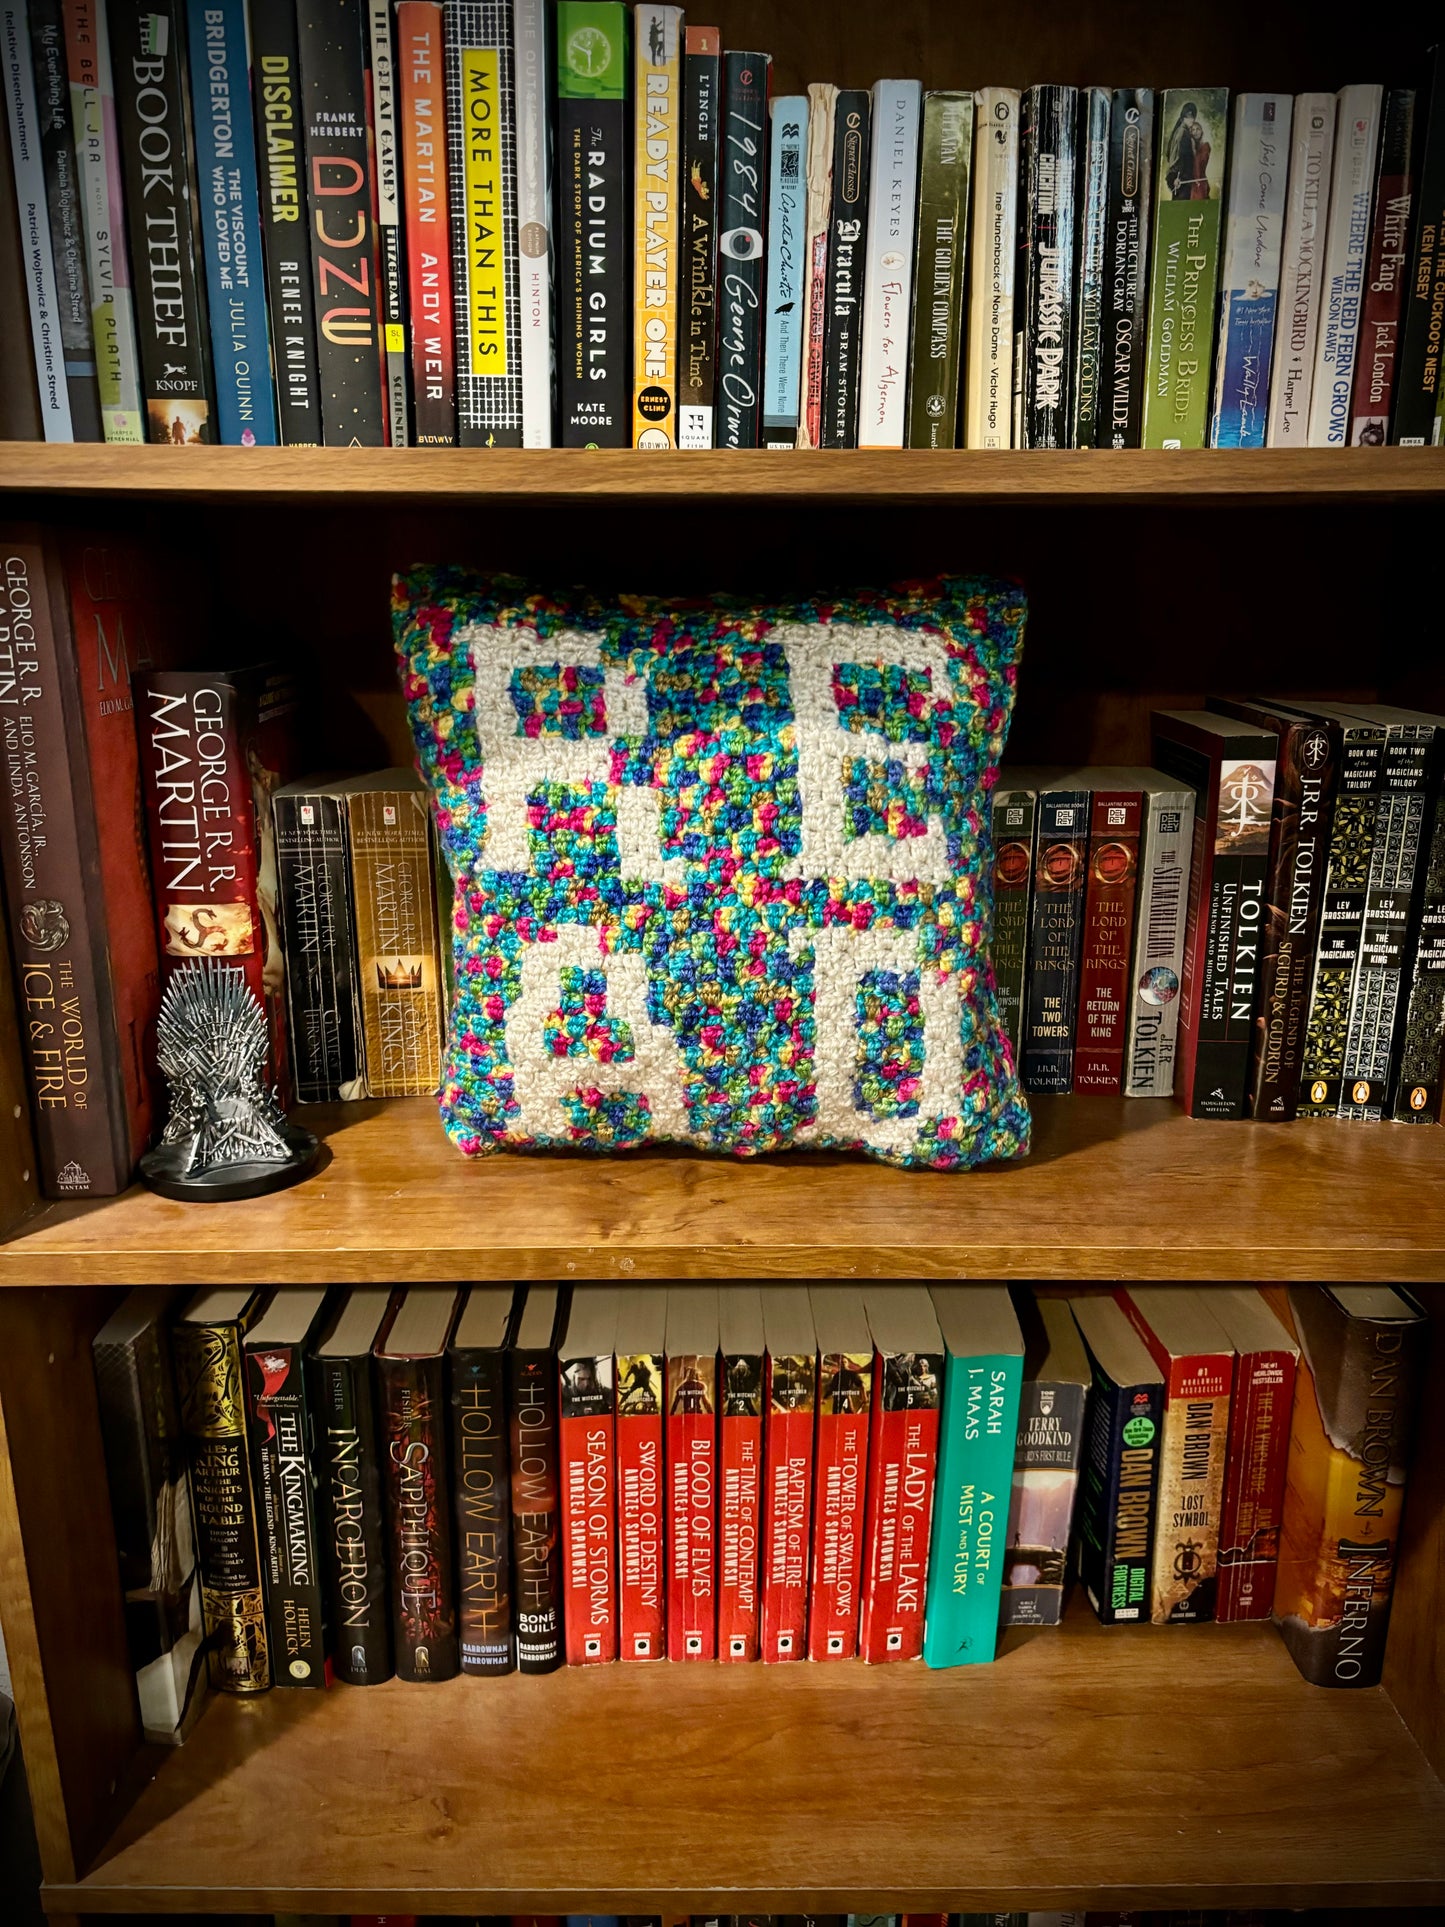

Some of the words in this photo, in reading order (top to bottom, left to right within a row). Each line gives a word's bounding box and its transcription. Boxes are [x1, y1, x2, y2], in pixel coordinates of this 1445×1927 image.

[75, 4, 91, 43] THE
[412, 32, 432, 84] THE
[79, 59, 96, 109] BELL
[204, 9, 235, 159] BRIDGERTON
[698, 75, 710, 142] L'ENGLE
[133, 56, 175, 200] BOOK
[261, 56, 300, 222] DISCLAIMER
[310, 126, 364, 138] HERBERT
[315, 112, 356, 123] FRANK
[469, 69, 492, 162] MORE
[646, 74, 670, 183] READY
[893, 100, 906, 169] DANIEL
[86, 124, 102, 163] JAR
[414, 99, 438, 223] MARTIAN
[727, 110, 763, 217] 1984
[889, 180, 902, 237] KEYES
[1038, 153, 1056, 215] CRICHTON
[28, 203, 40, 246] Patricia
[473, 180, 496, 268] THAN
[588, 151, 606, 274] RADIUM
[692, 213, 709, 233] A
[935, 216, 955, 244] THE
[1128, 218, 1138, 241] THE
[644, 191, 669, 309] PLAYER
[1115, 221, 1127, 276] DORIAN
[1420, 224, 1437, 254] KEN
[32, 249, 46, 308] Wojtowicz
[96, 231, 114, 304] SYLVIA
[146, 206, 188, 348] THIEF
[420, 252, 441, 325] ANDY
[691, 234, 713, 316] Wrinkle
[933, 247, 953, 296] GOLDEN
[1127, 241, 1140, 300] PICTURE
[1164, 241, 1181, 312] WILLIAM
[1415, 256, 1433, 301] KESEY
[39, 311, 49, 319] &
[531, 272, 541, 328] HINTON
[881, 282, 902, 330] Flowers
[1037, 241, 1066, 345] JURASSIC
[1112, 278, 1125, 312] GRAY
[1126, 301, 1135, 316] OF
[229, 298, 247, 352] JULIA
[476, 286, 498, 356] THIS
[589, 292, 607, 381] GIRLS
[690, 320, 707, 336] in
[779, 337, 790, 351] Then
[780, 320, 790, 334] And
[929, 300, 950, 360] COMPASS
[1370, 319, 1398, 351] Jack
[41, 322, 54, 371] Christine
[104, 318, 122, 382] PLATH
[424, 336, 443, 401] WEIR
[644, 317, 668, 379] ONE
[689, 341, 711, 389] Time
[778, 353, 790, 374] There
[838, 332, 849, 373] BRAM
[882, 338, 894, 354] for
[1113, 319, 1133, 375] OSCAR
[1156, 317, 1175, 398] GOLDMAN
[48, 374, 61, 410] Streed
[155, 379, 198, 391] KNOPF
[234, 360, 254, 422] QUINN
[777, 375, 789, 394] Were
[876, 365, 899, 426] Algernon
[989, 368, 1000, 394] Victor
[1035, 347, 1065, 410] PARK
[1369, 352, 1396, 404] London
[570, 417, 613, 426] MOORE
[576, 402, 606, 412] KATE
[776, 395, 788, 414] None
[835, 377, 848, 438] STOKER
[987, 396, 999, 429] Hugo
[1111, 376, 1130, 431] WILDE
[3, 716, 19, 751] AND
[192, 688, 233, 823] GEORGE
[8, 754, 24, 798] LINDA
[146, 688, 206, 894] MARTIN
[1299, 775, 1322, 833] J.R.R.
[14, 802, 37, 890] ANTONSSON
[204, 830, 233, 859] R.
[357, 838, 398, 846] BESTSELLING
[399, 837, 425, 845] AUTHOR
[208, 864, 237, 894] R.
[1287, 837, 1316, 937] TOLKIEN
[291, 863, 321, 953] MARTIN
[374, 862, 402, 951] MARTIN
[1365, 910, 1406, 920] GROSSMAN
[1034, 959, 1076, 972] RINGS
[1230, 879, 1263, 1022] TOLKIEN
[1294, 957, 1306, 978] THE
[1362, 944, 1399, 954] MAGICIAN
[1032, 1025, 1069, 1037] TOWERS
[1086, 1001, 1120, 1012] RETURN
[1284, 979, 1304, 1049] LEGEND
[303, 1008, 323, 1075] THRONES
[380, 1002, 406, 1073] KINGS
[1131, 1010, 1163, 1090] TOLKIEN
[1284, 1050, 1296, 1071] OF
[1027, 1077, 1068, 1086] TOLKIEN
[1078, 1076, 1119, 1085] TOLKIEN
[906, 1385, 926, 1393] WITCHER
[1197, 1367, 1208, 1378] #1
[1251, 1376, 1284, 1386] BESTSELLER
[1368, 1331, 1404, 1398] DAN
[689, 1397, 695, 1410] 1
[789, 1397, 797, 1409] 3
[842, 1398, 850, 1411] 4
[907, 1394, 915, 1406] 5
[986, 1370, 1007, 1435] SARAH
[1028, 1417, 1063, 1432] TERRY
[1185, 1402, 1214, 1430] DAN
[638, 1441, 657, 1508] SWORD
[690, 1439, 712, 1509] BLOOD
[1181, 1433, 1211, 1481] BROWN
[1352, 1409, 1395, 1518] BROWN
[263, 1485, 273, 1501] THE
[825, 1466, 842, 1518] ANDRZEJ
[882, 1463, 900, 1515] ANDRZEJ
[264, 1501, 275, 1532] LEGEND
[389, 1440, 438, 1616] SAPPHIQUE
[639, 1512, 657, 1536] OF
[691, 1515, 712, 1542] OF
[1171, 1511, 1210, 1528] SYMBOL
[268, 1535, 279, 1553] KING
[822, 1520, 840, 1586] SAPKOWSKI
[878, 1517, 898, 1583] SAPKOWSKI
[269, 1553, 281, 1586] ARTHUR
[639, 1541, 658, 1609] DESTINY
[691, 1548, 712, 1598] ELVES
[283, 1599, 299, 1658] HOLLICK
[296, 1607, 312, 1650] HELEN
[518, 1609, 557, 1624] BONE
[1333, 1545, 1389, 1681] INFERNO
[462, 1643, 508, 1654] BARROWMAN
[462, 1655, 509, 1666] BARROWMAN
